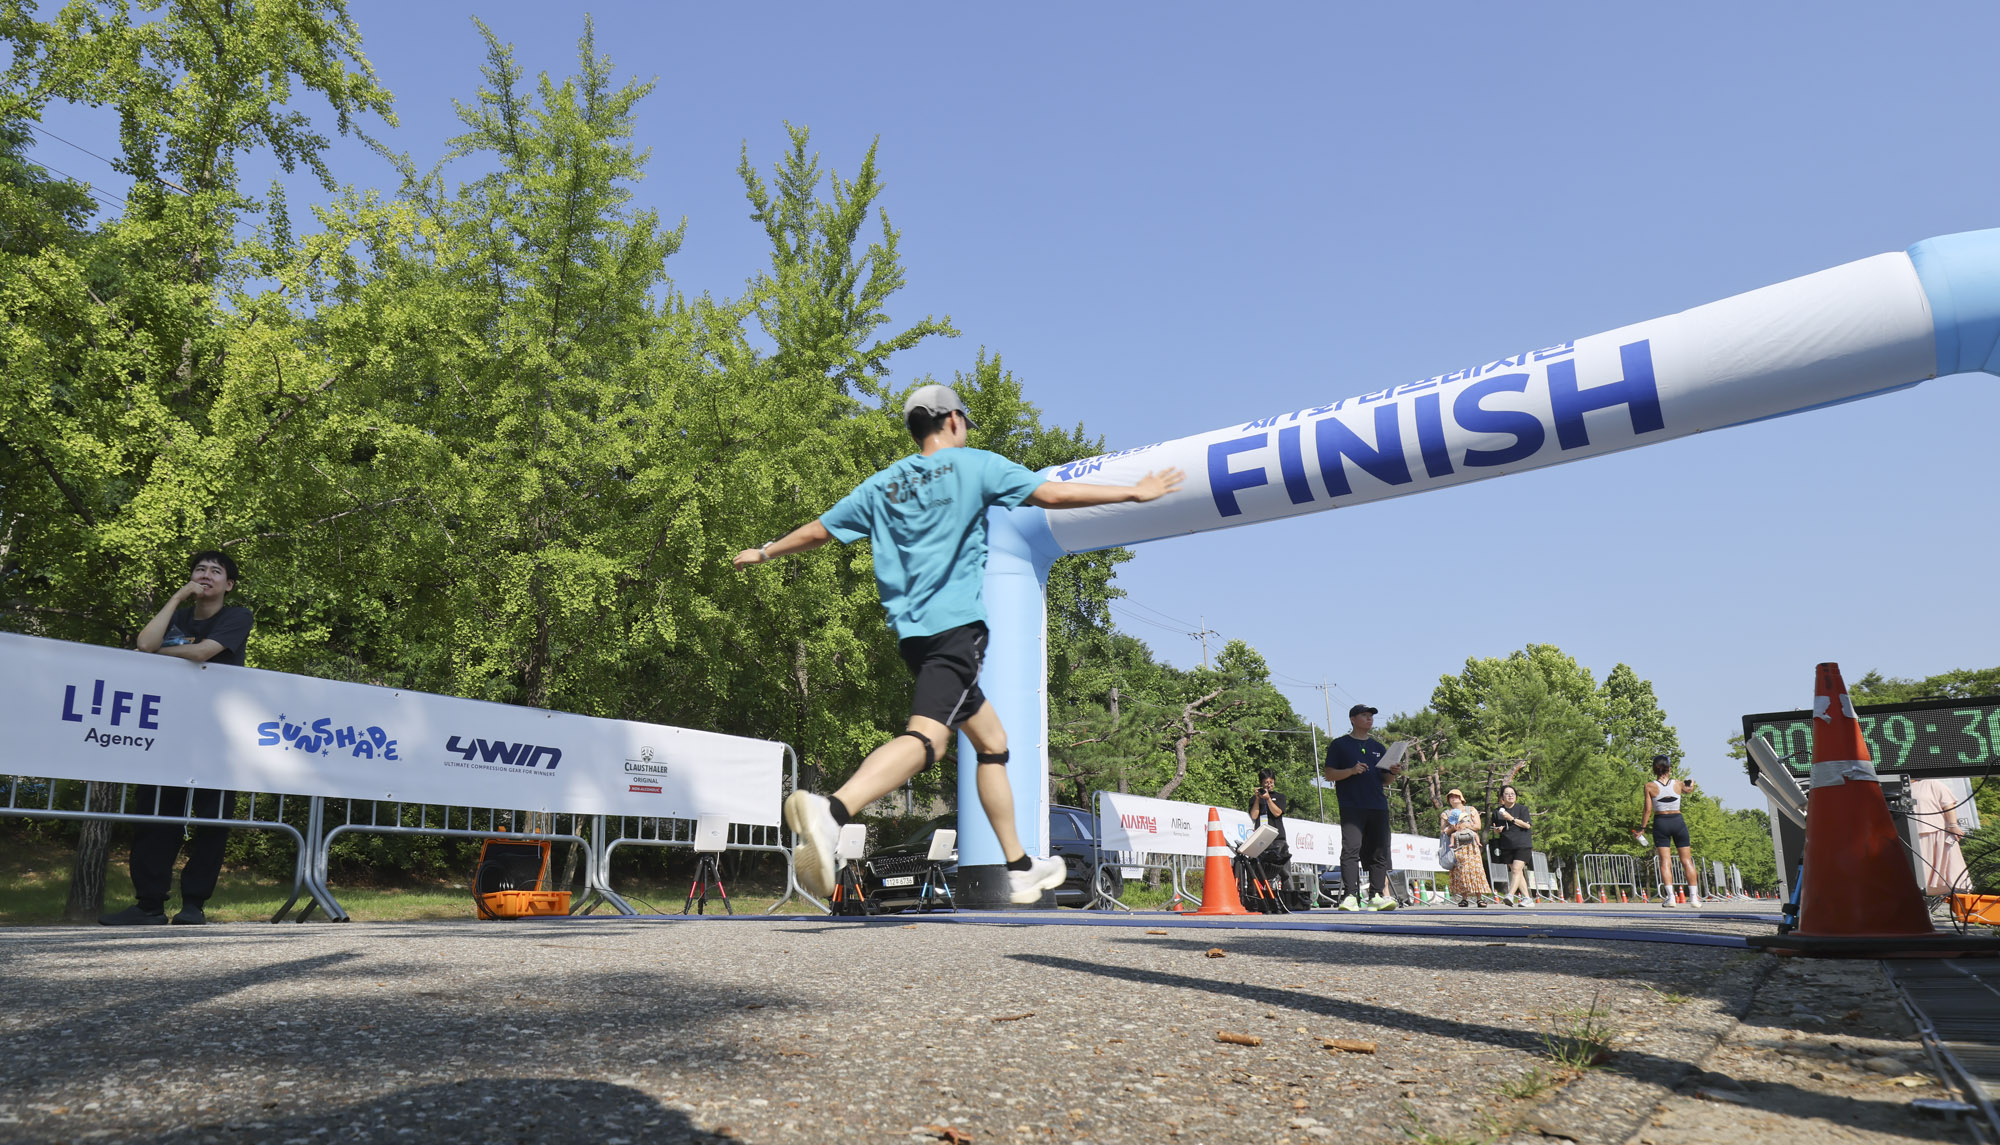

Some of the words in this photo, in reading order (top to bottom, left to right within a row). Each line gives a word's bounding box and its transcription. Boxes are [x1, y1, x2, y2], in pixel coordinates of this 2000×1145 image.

[1207, 338, 1665, 517] FINISH
[84, 727, 155, 751] Agency
[257, 717, 399, 761] SUNSHADE
[443, 761, 470, 769] ULTIMATE
[471, 763, 508, 772] COMPRESSION
[633, 776, 659, 784] ORIGINAL
[1120, 814, 1157, 834] 시사저널
